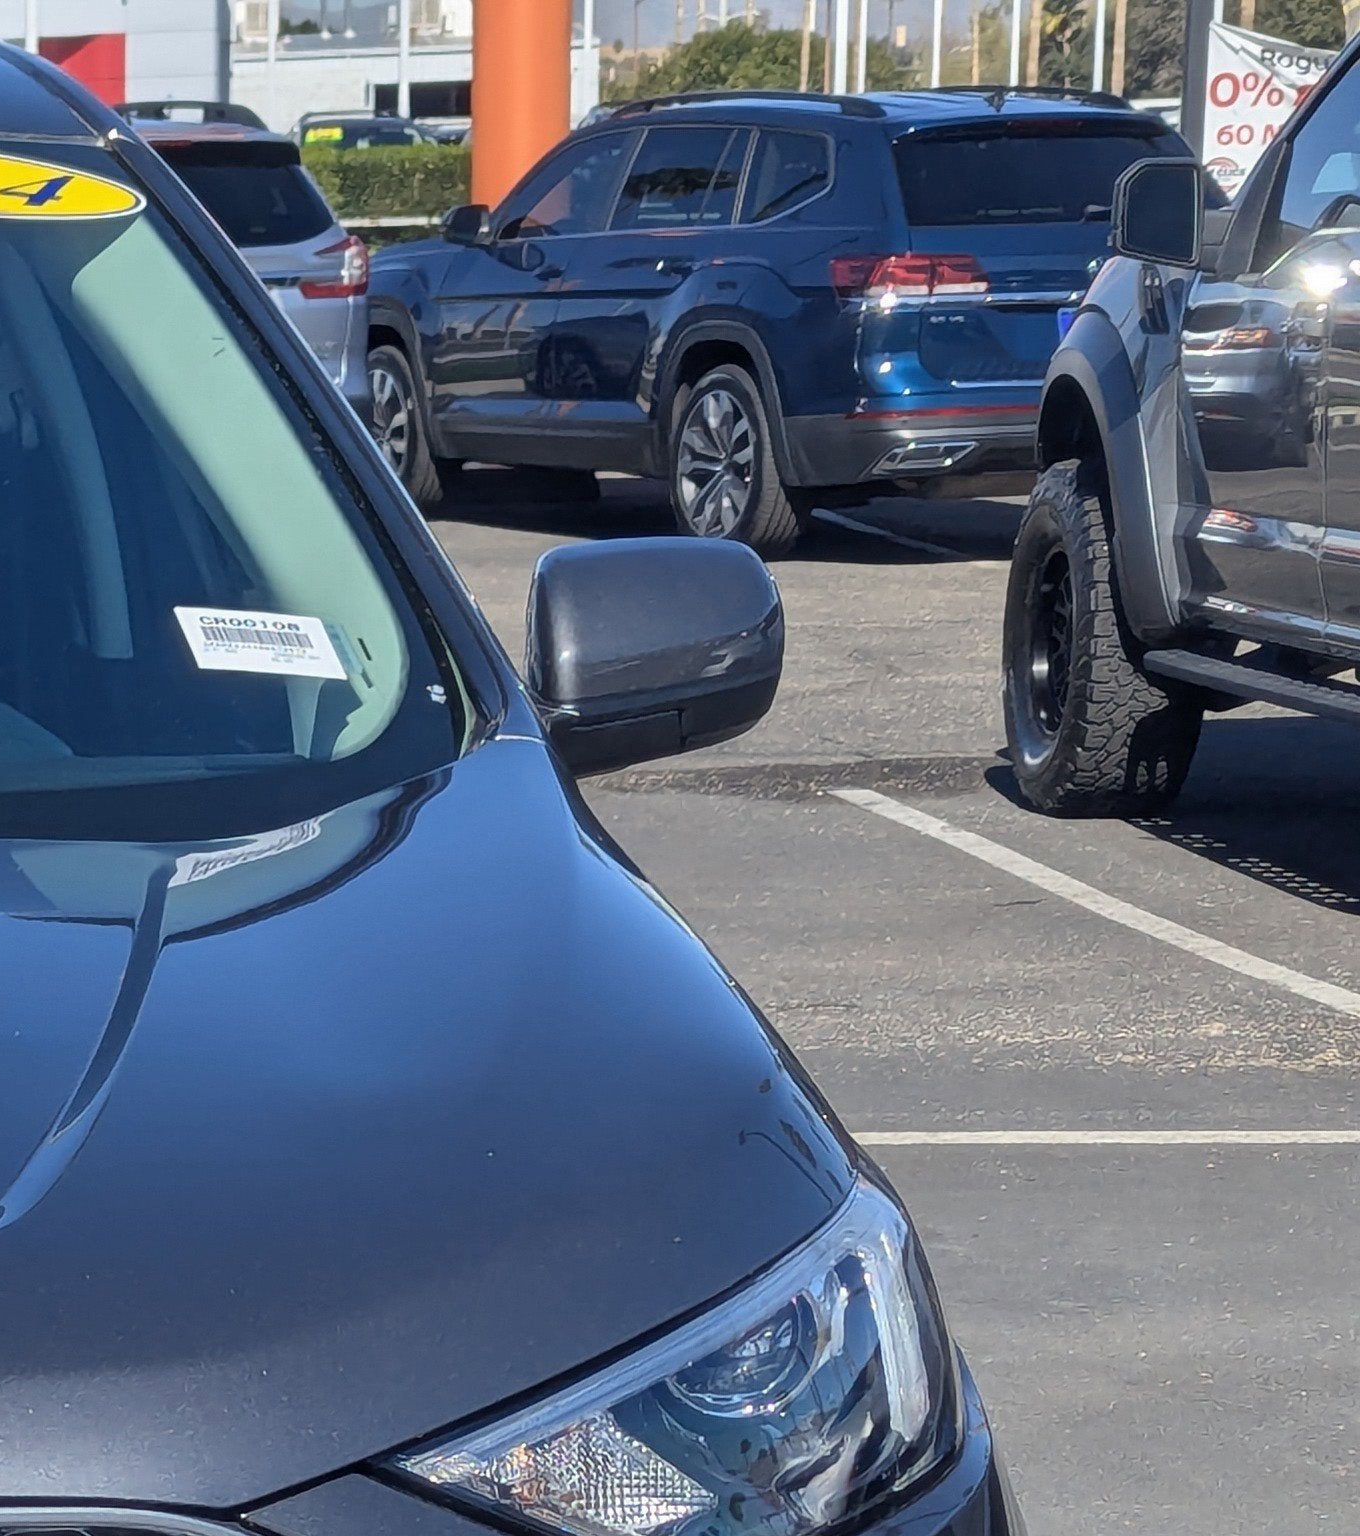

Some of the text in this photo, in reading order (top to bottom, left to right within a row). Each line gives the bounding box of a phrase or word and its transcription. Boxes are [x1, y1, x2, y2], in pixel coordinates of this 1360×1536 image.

[1260, 48, 1332, 75] Rogu
[1209, 72, 1285, 108] 0%
[1216, 124, 1255, 146] 60
